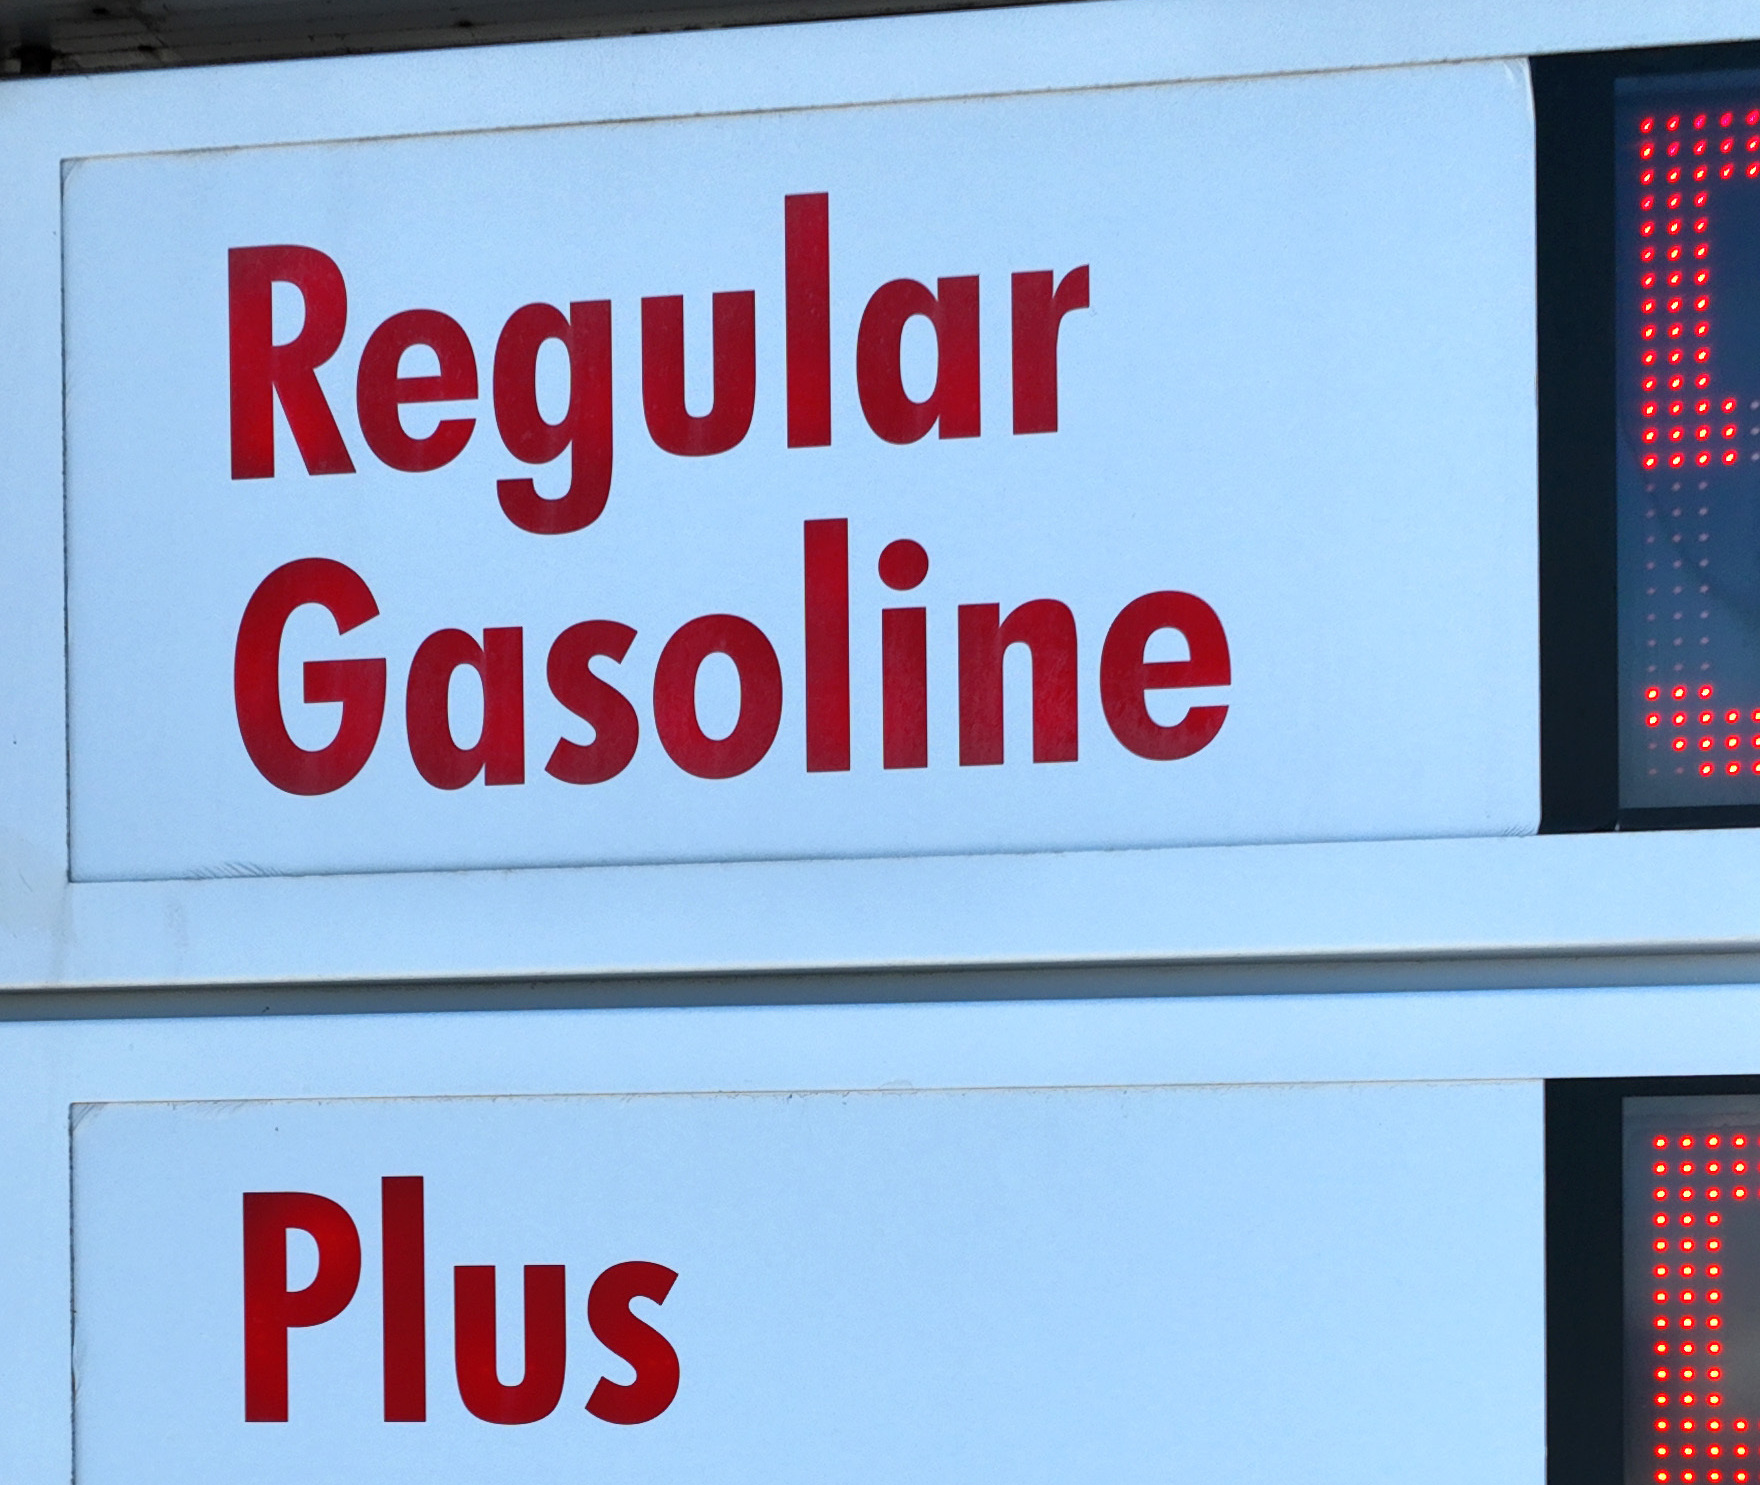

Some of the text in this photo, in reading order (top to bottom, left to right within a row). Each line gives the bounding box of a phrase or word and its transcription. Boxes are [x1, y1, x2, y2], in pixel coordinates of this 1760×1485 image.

[231, 194, 1090, 535] Regular
[235, 514, 1232, 793] Gasoline
[244, 1176, 681, 1425] Plus
